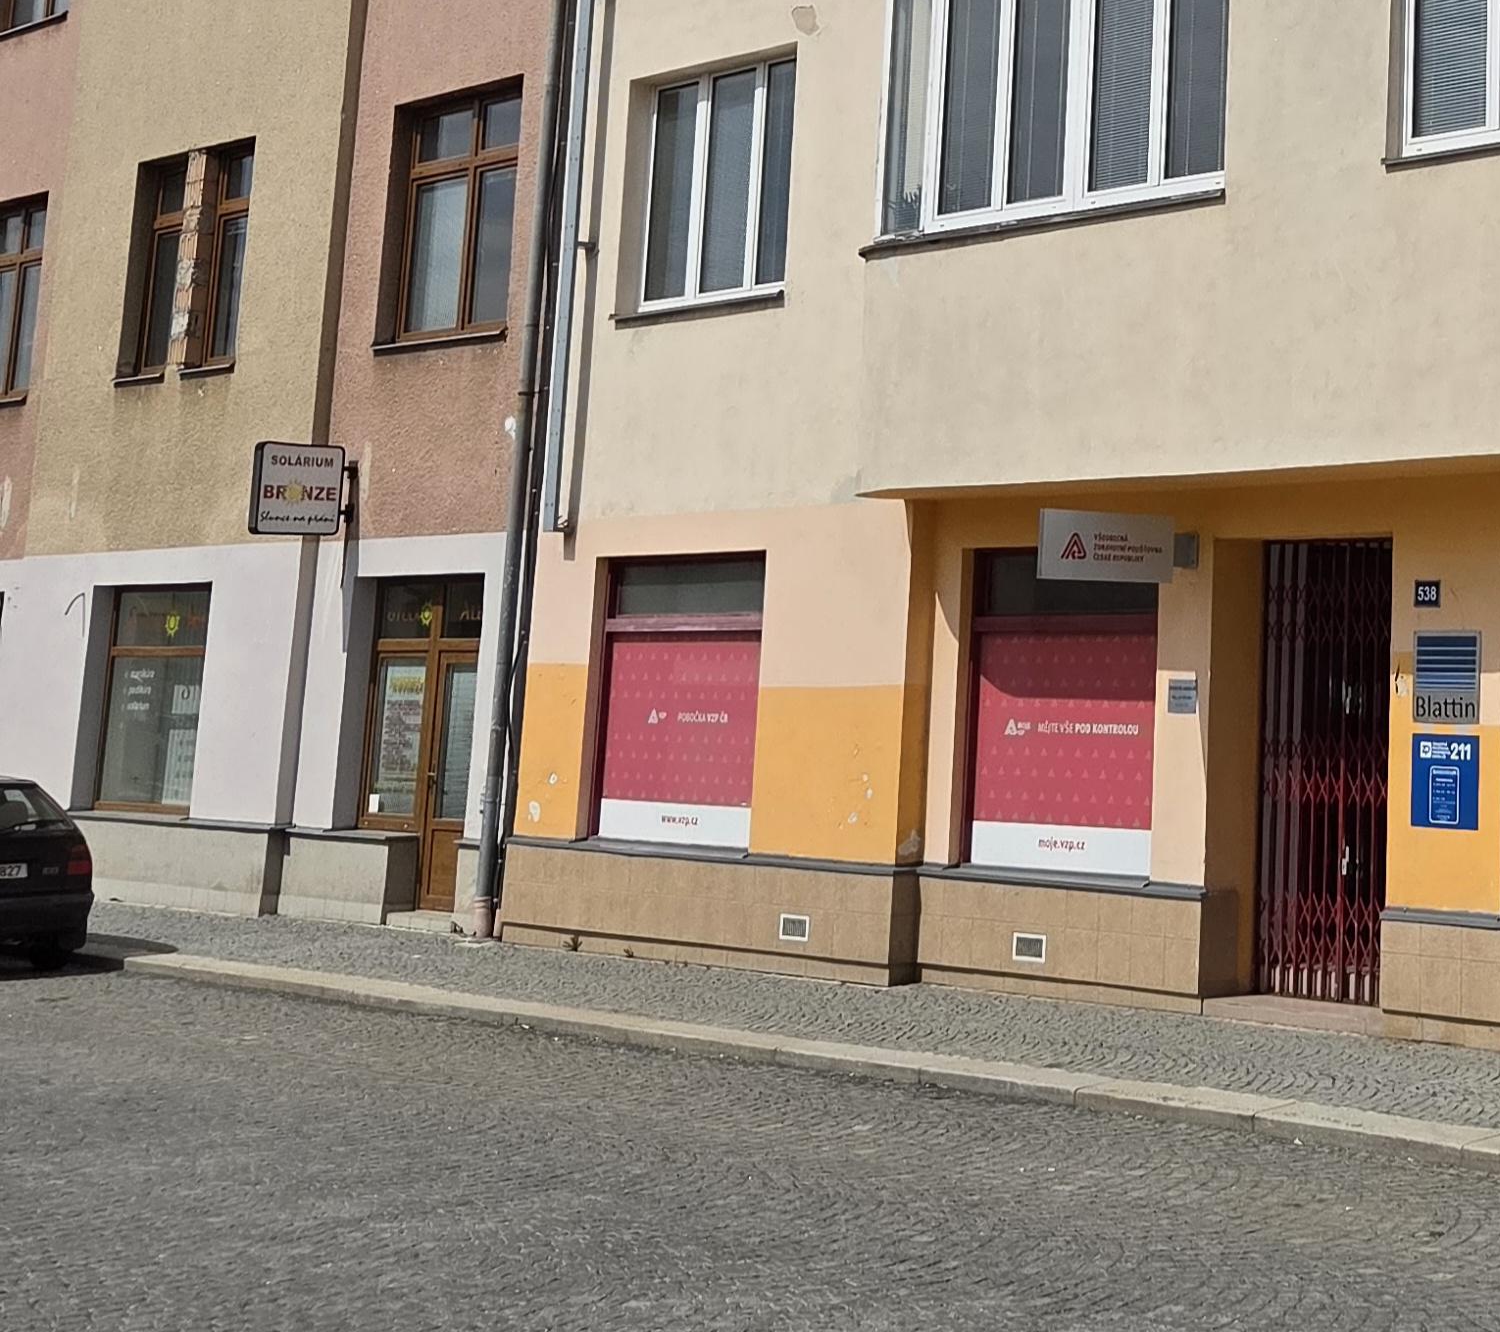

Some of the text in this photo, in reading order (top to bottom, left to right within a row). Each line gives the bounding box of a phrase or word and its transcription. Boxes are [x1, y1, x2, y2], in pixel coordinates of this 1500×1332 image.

[271, 453, 334, 468] SOLÁRIUM
[1417, 586, 1437, 601] 538
[1416, 695, 1476, 718] Blattin
[1092, 723, 1139, 735] KONTROLOU
[1450, 742, 1472, 761] 211
[1039, 836, 1085, 852] moje.vzp.cz
